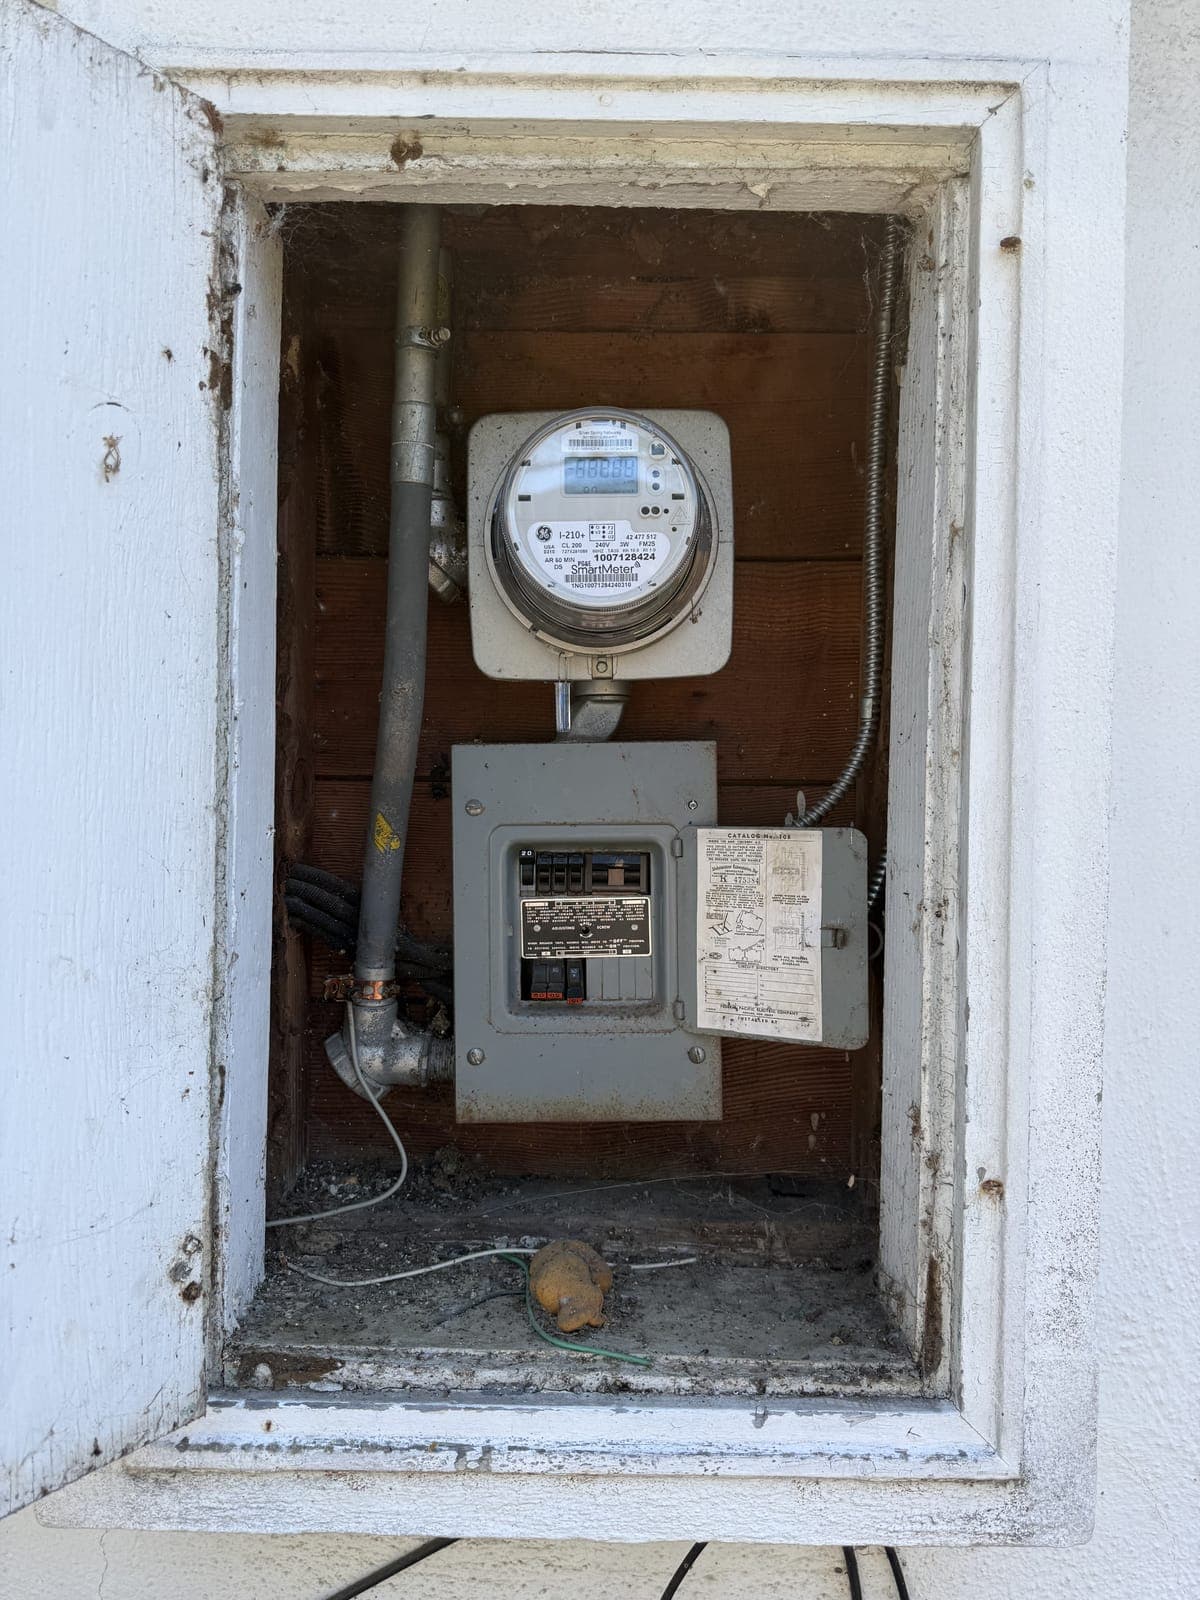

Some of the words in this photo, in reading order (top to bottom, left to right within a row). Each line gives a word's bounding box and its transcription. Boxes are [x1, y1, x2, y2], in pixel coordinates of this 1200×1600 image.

[559, 530, 586, 540] I-210+
[594, 552, 656, 562] 1007128424
[571, 564, 634, 574] SmartMeter
